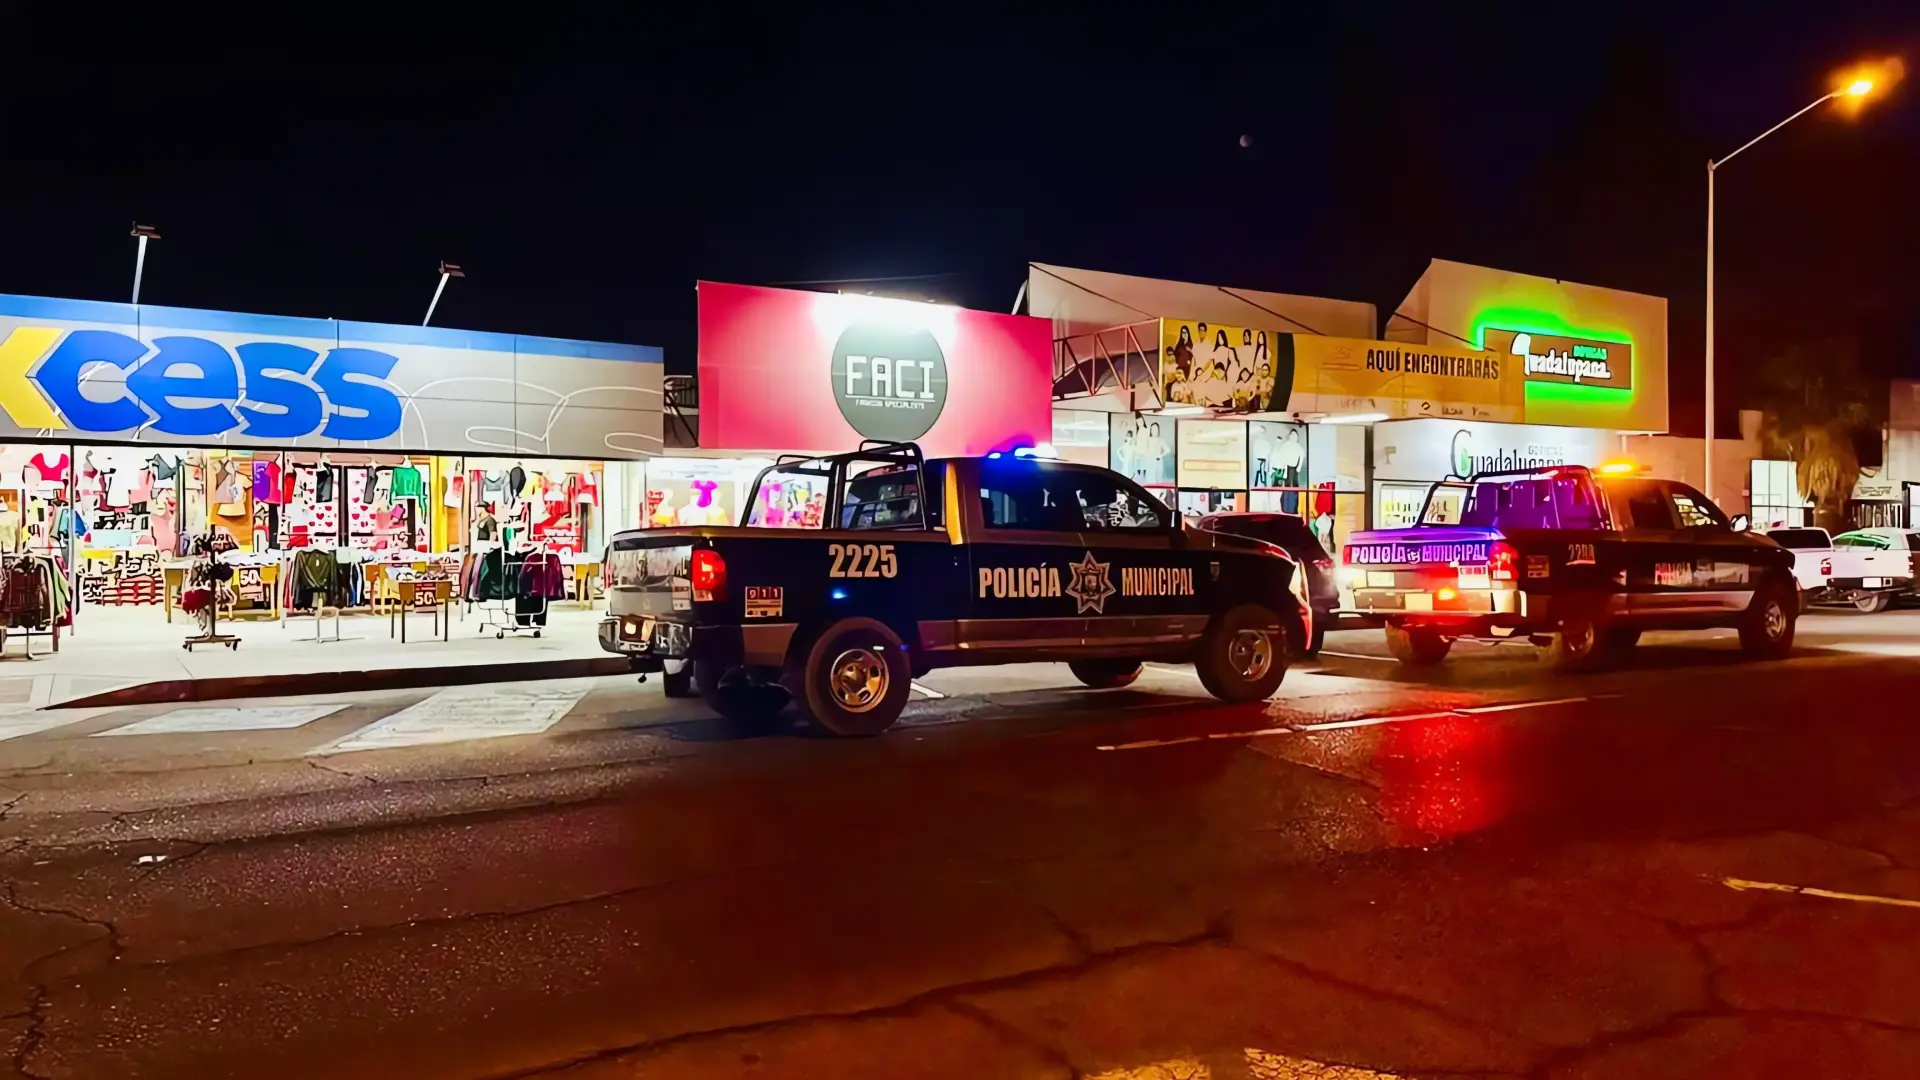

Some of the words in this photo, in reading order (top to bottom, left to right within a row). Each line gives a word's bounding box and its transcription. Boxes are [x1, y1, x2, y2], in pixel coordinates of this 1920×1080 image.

[846, 355, 935, 399] FACI
[1366, 347, 1400, 373] AQUÍ
[1404, 351, 1499, 380] ENCONTRARÁS
[828, 543, 898, 578] 2225
[978, 562, 1062, 598] POLICÍA
[1121, 567, 1195, 597] MUNICIPAL
